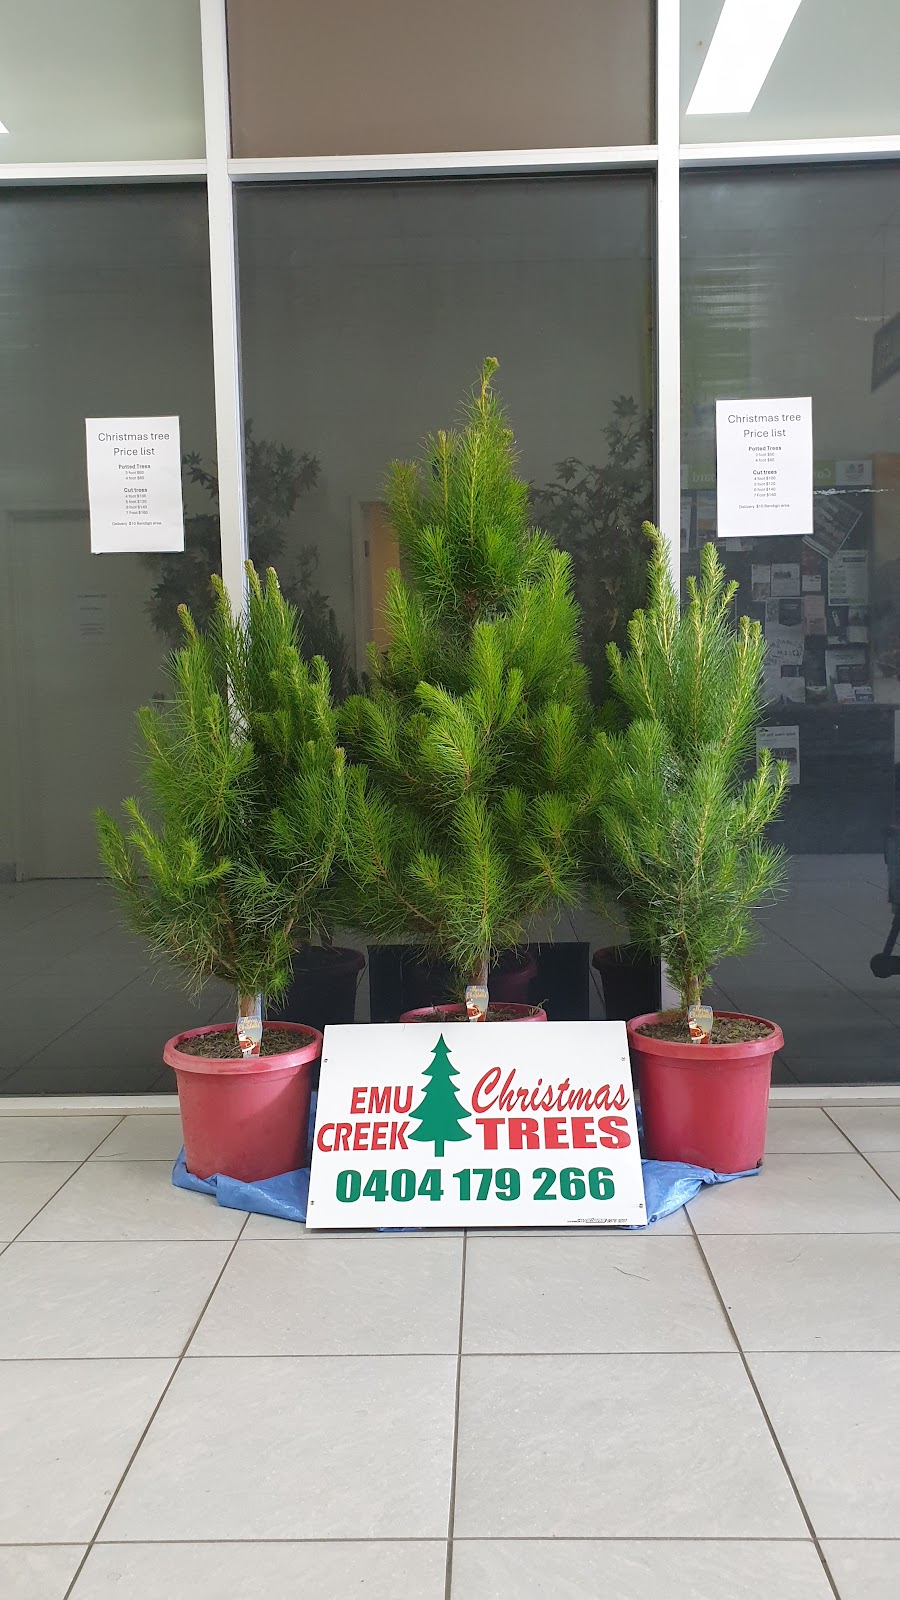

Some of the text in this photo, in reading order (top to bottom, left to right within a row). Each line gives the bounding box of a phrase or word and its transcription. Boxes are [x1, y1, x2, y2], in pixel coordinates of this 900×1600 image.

[727, 414, 802, 424] Christmas tree
[743, 428, 787, 438] Price list
[98, 432, 170, 442] Christmas tree
[113, 446, 155, 456] Price list
[349, 1085, 414, 1115] EMU
[471, 1066, 630, 1114] Christmas
[316, 1120, 410, 1152] CREEK
[474, 1115, 632, 1150] TREES
[335, 1166, 615, 1203] 0404 179 266
